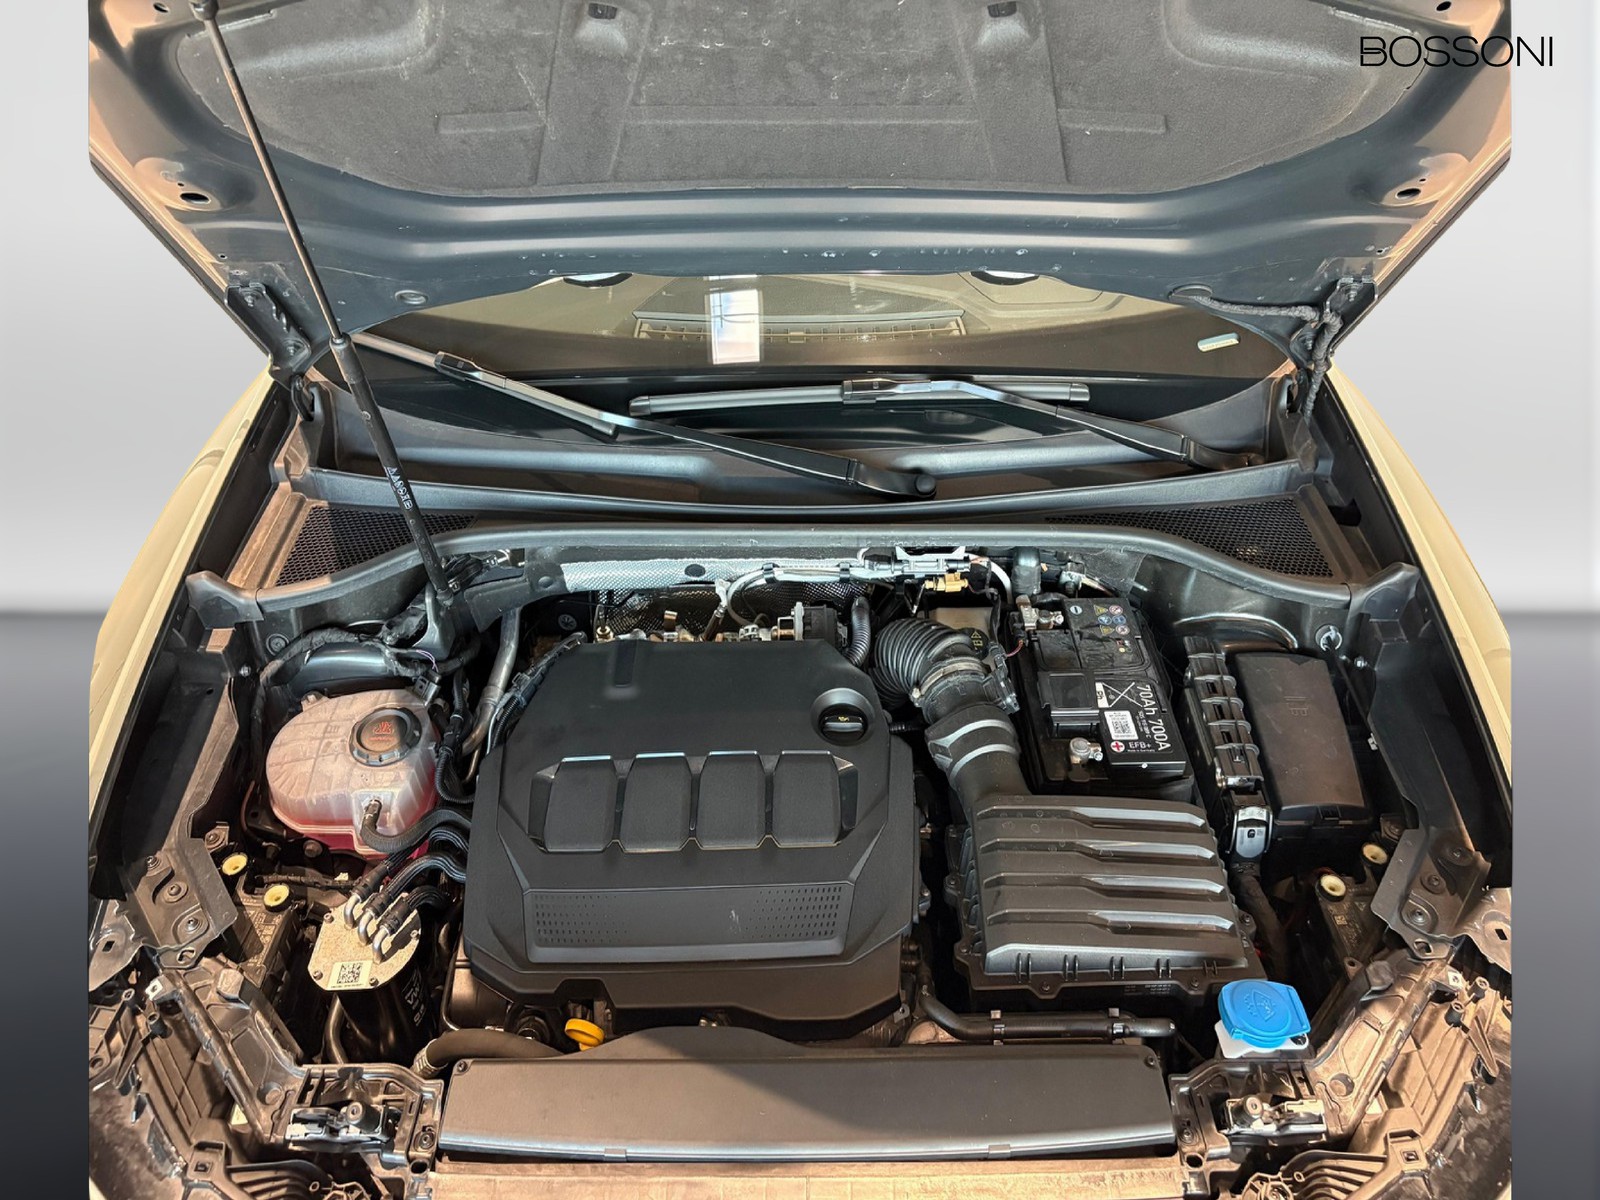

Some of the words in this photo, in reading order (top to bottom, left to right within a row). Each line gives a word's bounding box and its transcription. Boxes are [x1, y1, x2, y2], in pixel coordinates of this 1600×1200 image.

[1136, 684, 1158, 715] 70Ah
[1148, 718, 1171, 751] 700A
[1128, 741, 1152, 749] EFB+
